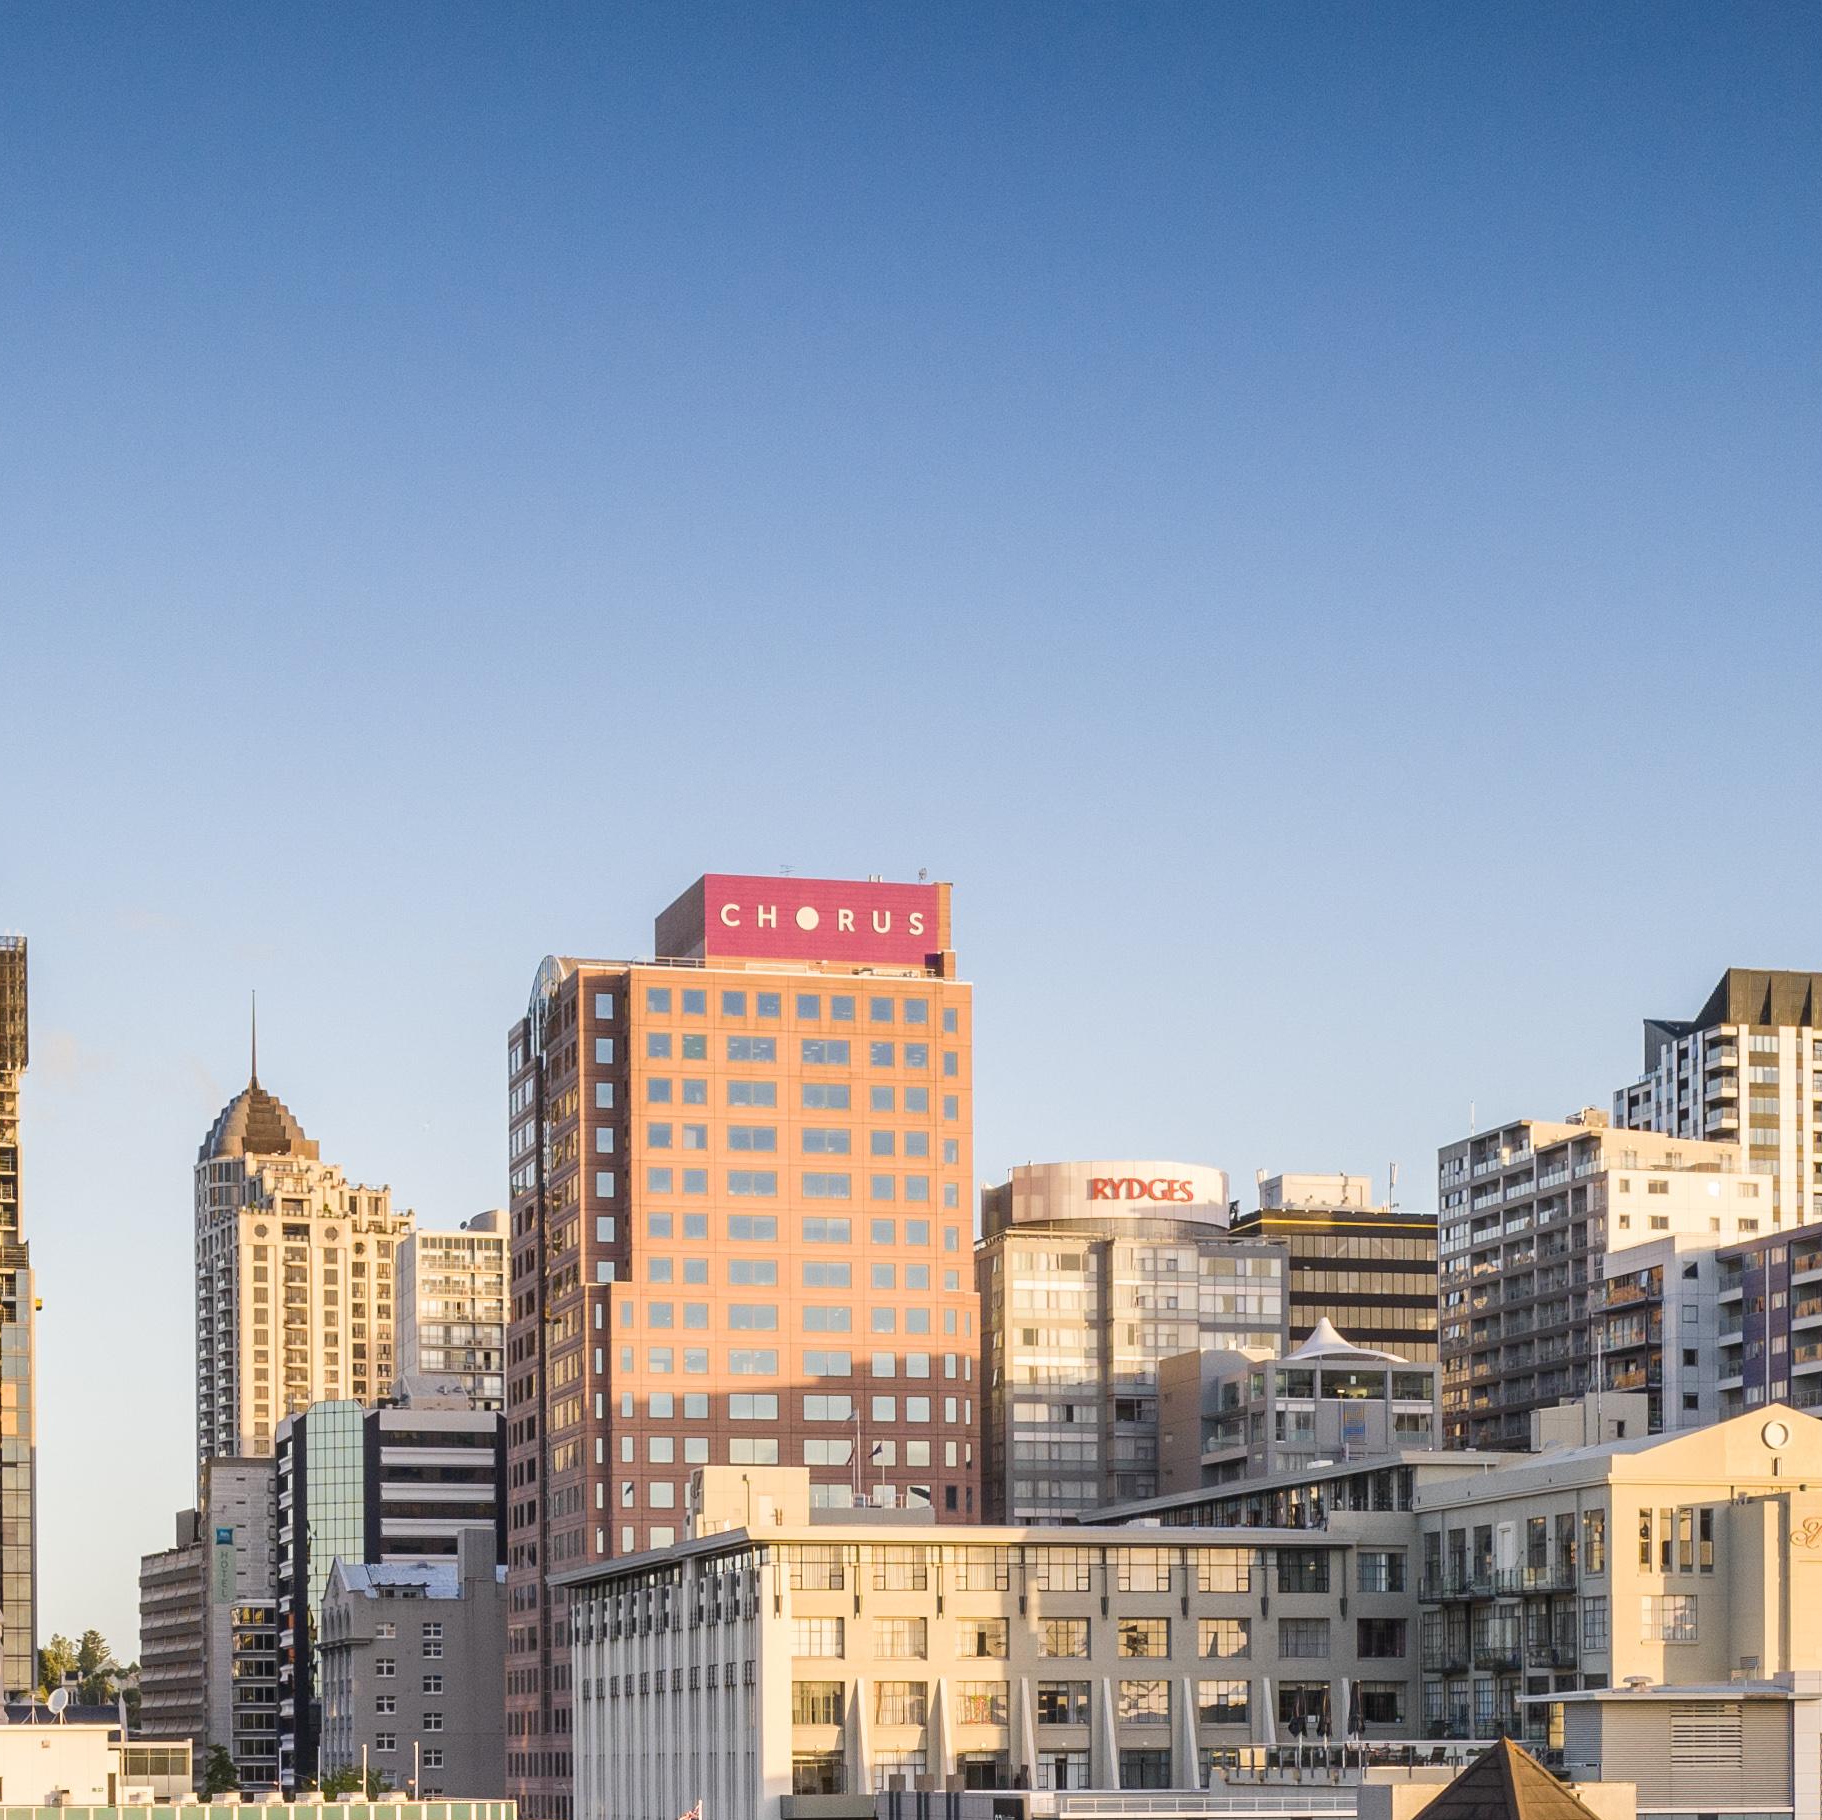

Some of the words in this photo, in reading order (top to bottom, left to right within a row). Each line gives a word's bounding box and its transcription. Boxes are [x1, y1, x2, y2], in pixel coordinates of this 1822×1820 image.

[720, 903, 924, 936] CHORUS
[1086, 1178, 1194, 1202] RYDGES
[220, 1551, 229, 1598] HOTEL
